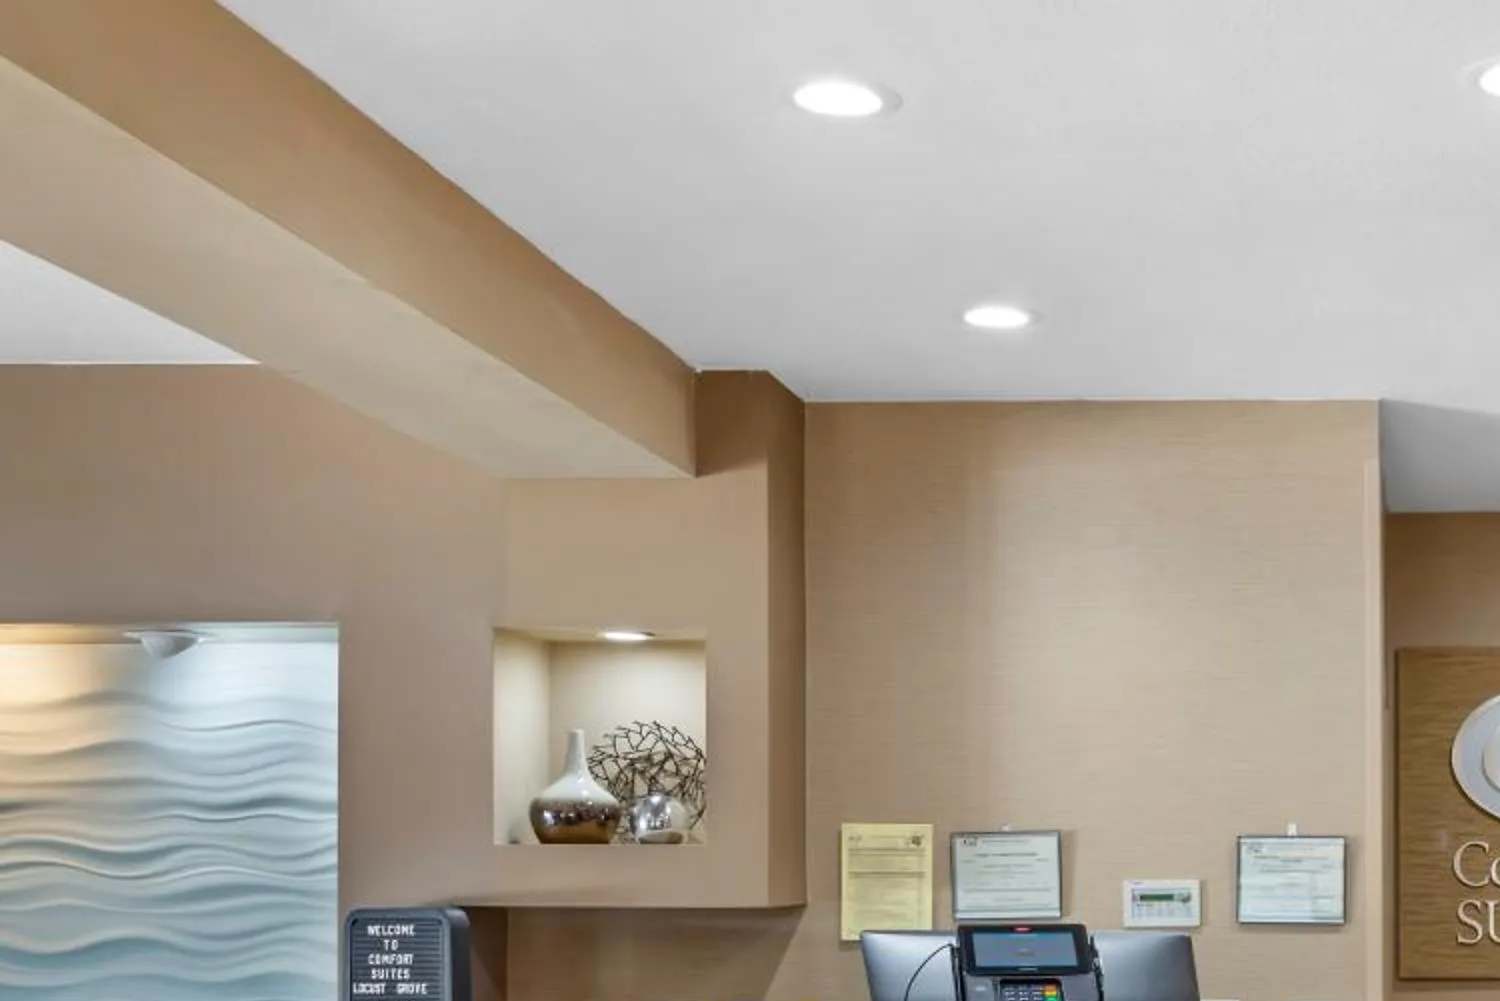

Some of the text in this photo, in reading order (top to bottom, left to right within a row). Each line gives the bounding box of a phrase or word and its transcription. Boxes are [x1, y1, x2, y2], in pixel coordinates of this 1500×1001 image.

[367, 924, 416, 937] WELCOME
[383, 939, 399, 951] TO
[367, 953, 414, 965] COMFORT
[371, 967, 410, 980] SUITES
[352, 982, 427, 995] LOCUST GROVE
